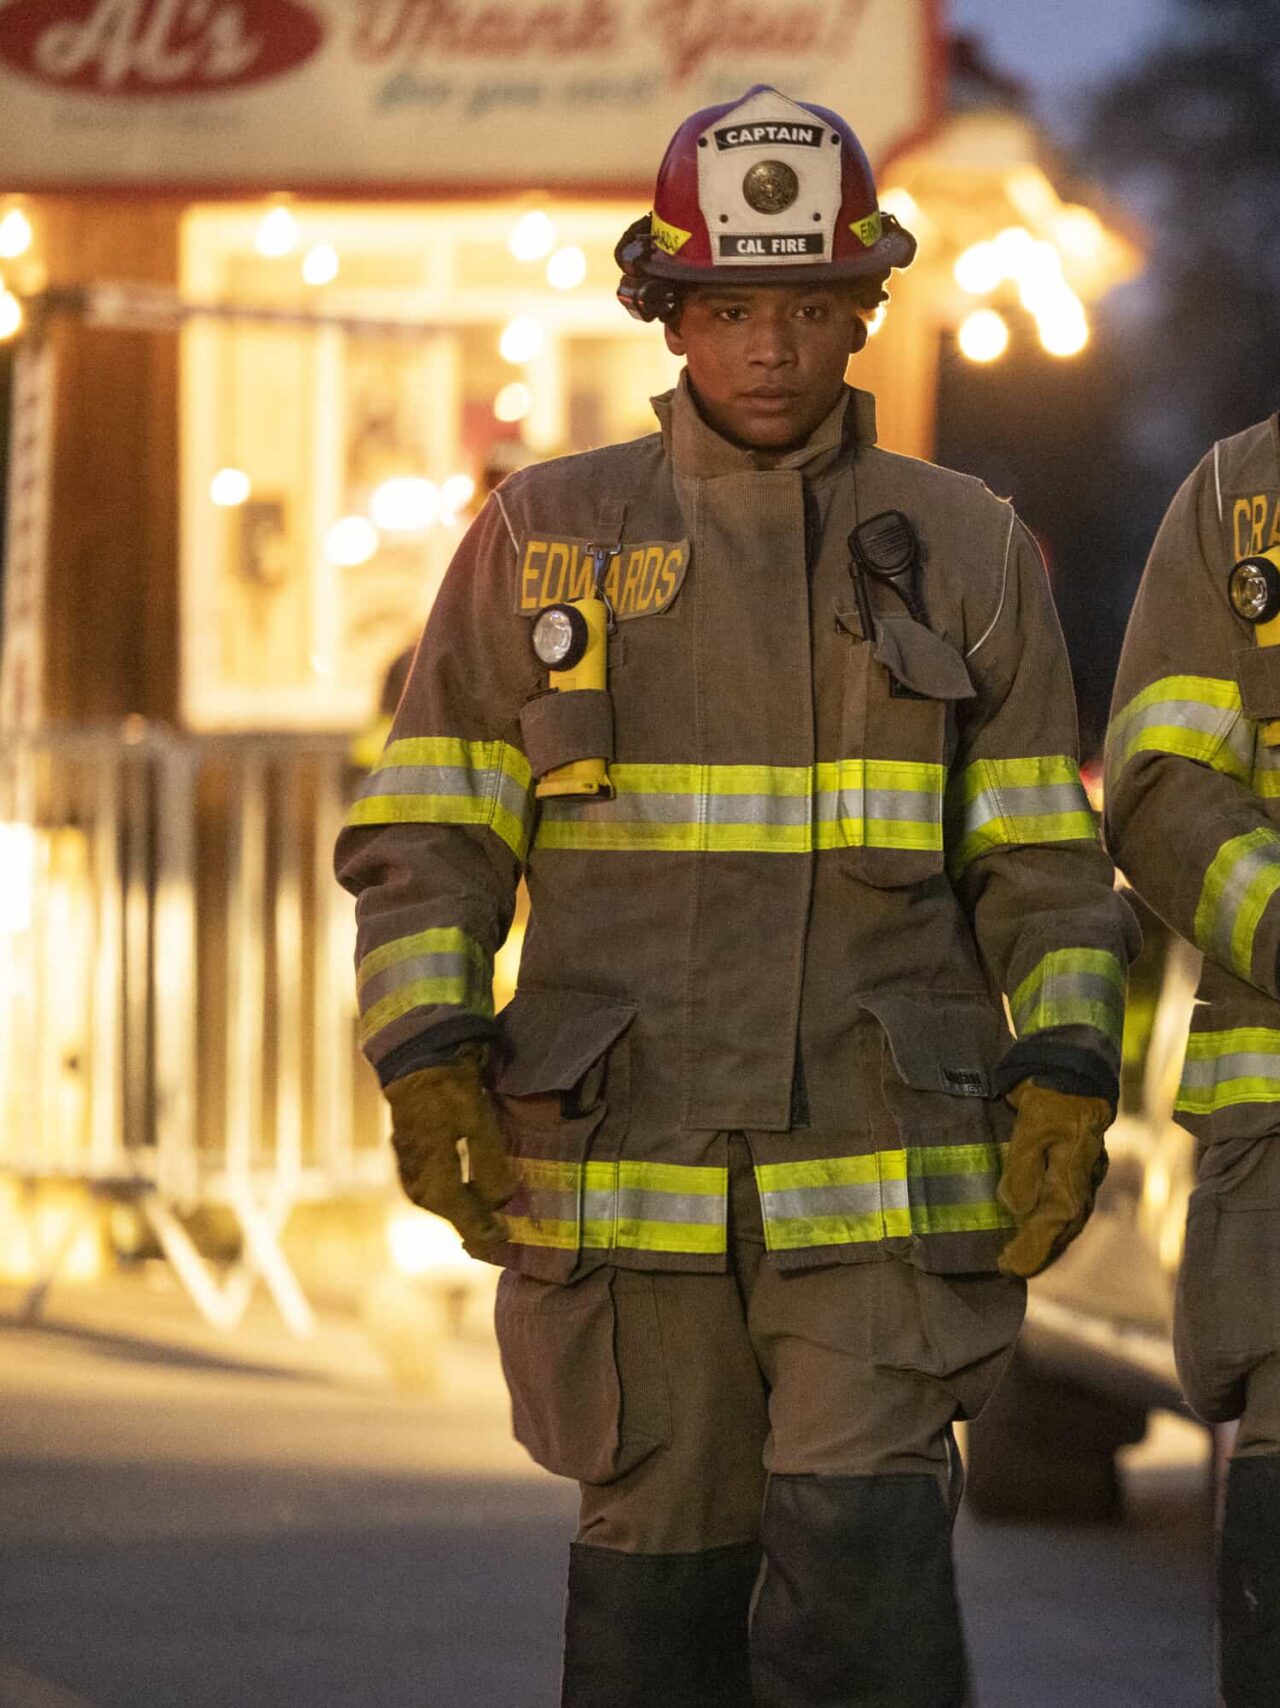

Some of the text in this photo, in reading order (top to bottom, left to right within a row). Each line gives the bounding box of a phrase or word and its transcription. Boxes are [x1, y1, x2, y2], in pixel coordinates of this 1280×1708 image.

[726, 126, 813, 144] CAPTAIN
[736, 238, 807, 253] CAL FIRE
[520, 540, 684, 612] EDWARDS
